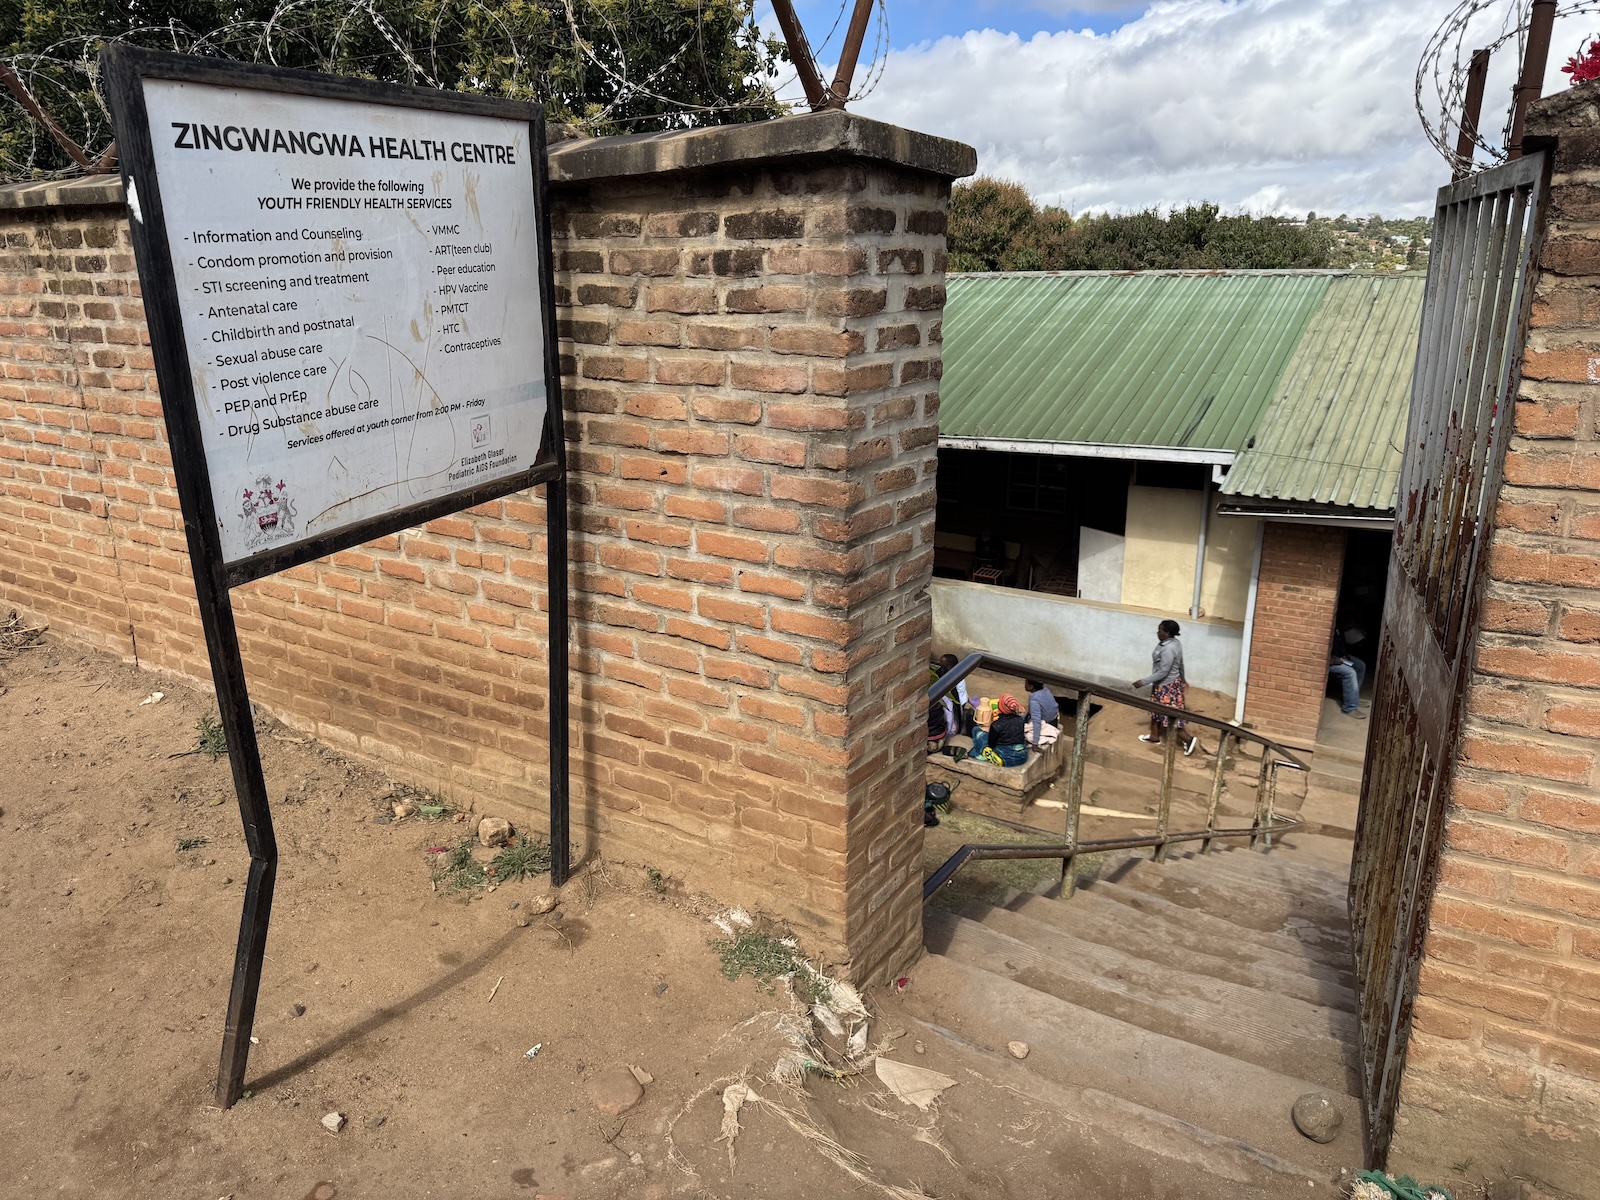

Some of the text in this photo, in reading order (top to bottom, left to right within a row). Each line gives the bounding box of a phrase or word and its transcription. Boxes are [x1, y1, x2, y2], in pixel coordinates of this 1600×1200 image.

[171, 122, 516, 165] ZINGWANGWA HEALTH CENTRE
[291, 178, 424, 194] We provide the following
[257, 197, 452, 209] YOUTH FRIENDLY HEALTH SERVICES
[193, 229, 272, 244] Information
[275, 228, 298, 241] and
[301, 227, 362, 241] Counseling
[432, 225, 460, 235] VMMC
[197, 255, 255, 269] Condom
[258, 251, 321, 268] promotion
[324, 250, 345, 262] and
[348, 248, 393, 263] provision
[434, 244, 472, 257] ART(teen
[473, 243, 493, 255] club)
[437, 265, 455, 275] Peer
[457, 262, 496, 274] education
[202, 281, 222, 294] STI
[225, 276, 287, 293] screening
[289, 275, 312, 287] and
[315, 271, 369, 286] treatment
[439, 285, 457, 295] HPV
[458, 281, 488, 293] Vaccine
[208, 301, 270, 319] Antenatal
[272, 300, 298, 312] care
[441, 303, 469, 315] PMTCT
[211, 324, 275, 343] Childbirth
[278, 322, 300, 334] and
[303, 316, 355, 335] postnatal
[443, 323, 460, 334] HTC
[444, 337, 501, 353] Contraceptives
[215, 351, 258, 367] Sexual
[261, 347, 296, 361] abuse
[299, 344, 323, 355] care
[220, 377, 250, 391] Post
[251, 371, 300, 385] violence
[303, 365, 327, 377] care
[224, 400, 251, 414] PEP
[253, 394, 277, 409] and
[279, 390, 307, 404] PrEp
[228, 423, 260, 437] Drug
[262, 410, 322, 430] Substance
[325, 405, 356, 417] abuse
[358, 399, 379, 410] care
[287, 434, 323, 449] Services
[325, 426, 355, 440] offered
[356, 424, 365, 433] at
[366, 418, 389, 433] youth
[390, 414, 415, 425] corner
[416, 410, 433, 420] from
[434, 405, 449, 416] 2:00
[450, 403, 461, 412] PM
[466, 398, 486, 408] Friday
[461, 448, 504, 466] Elizabeth Glaser
[448, 466, 475, 481] Pediatric
[476, 462, 488, 473] AIDS
[489, 455, 517, 469] Foundation
